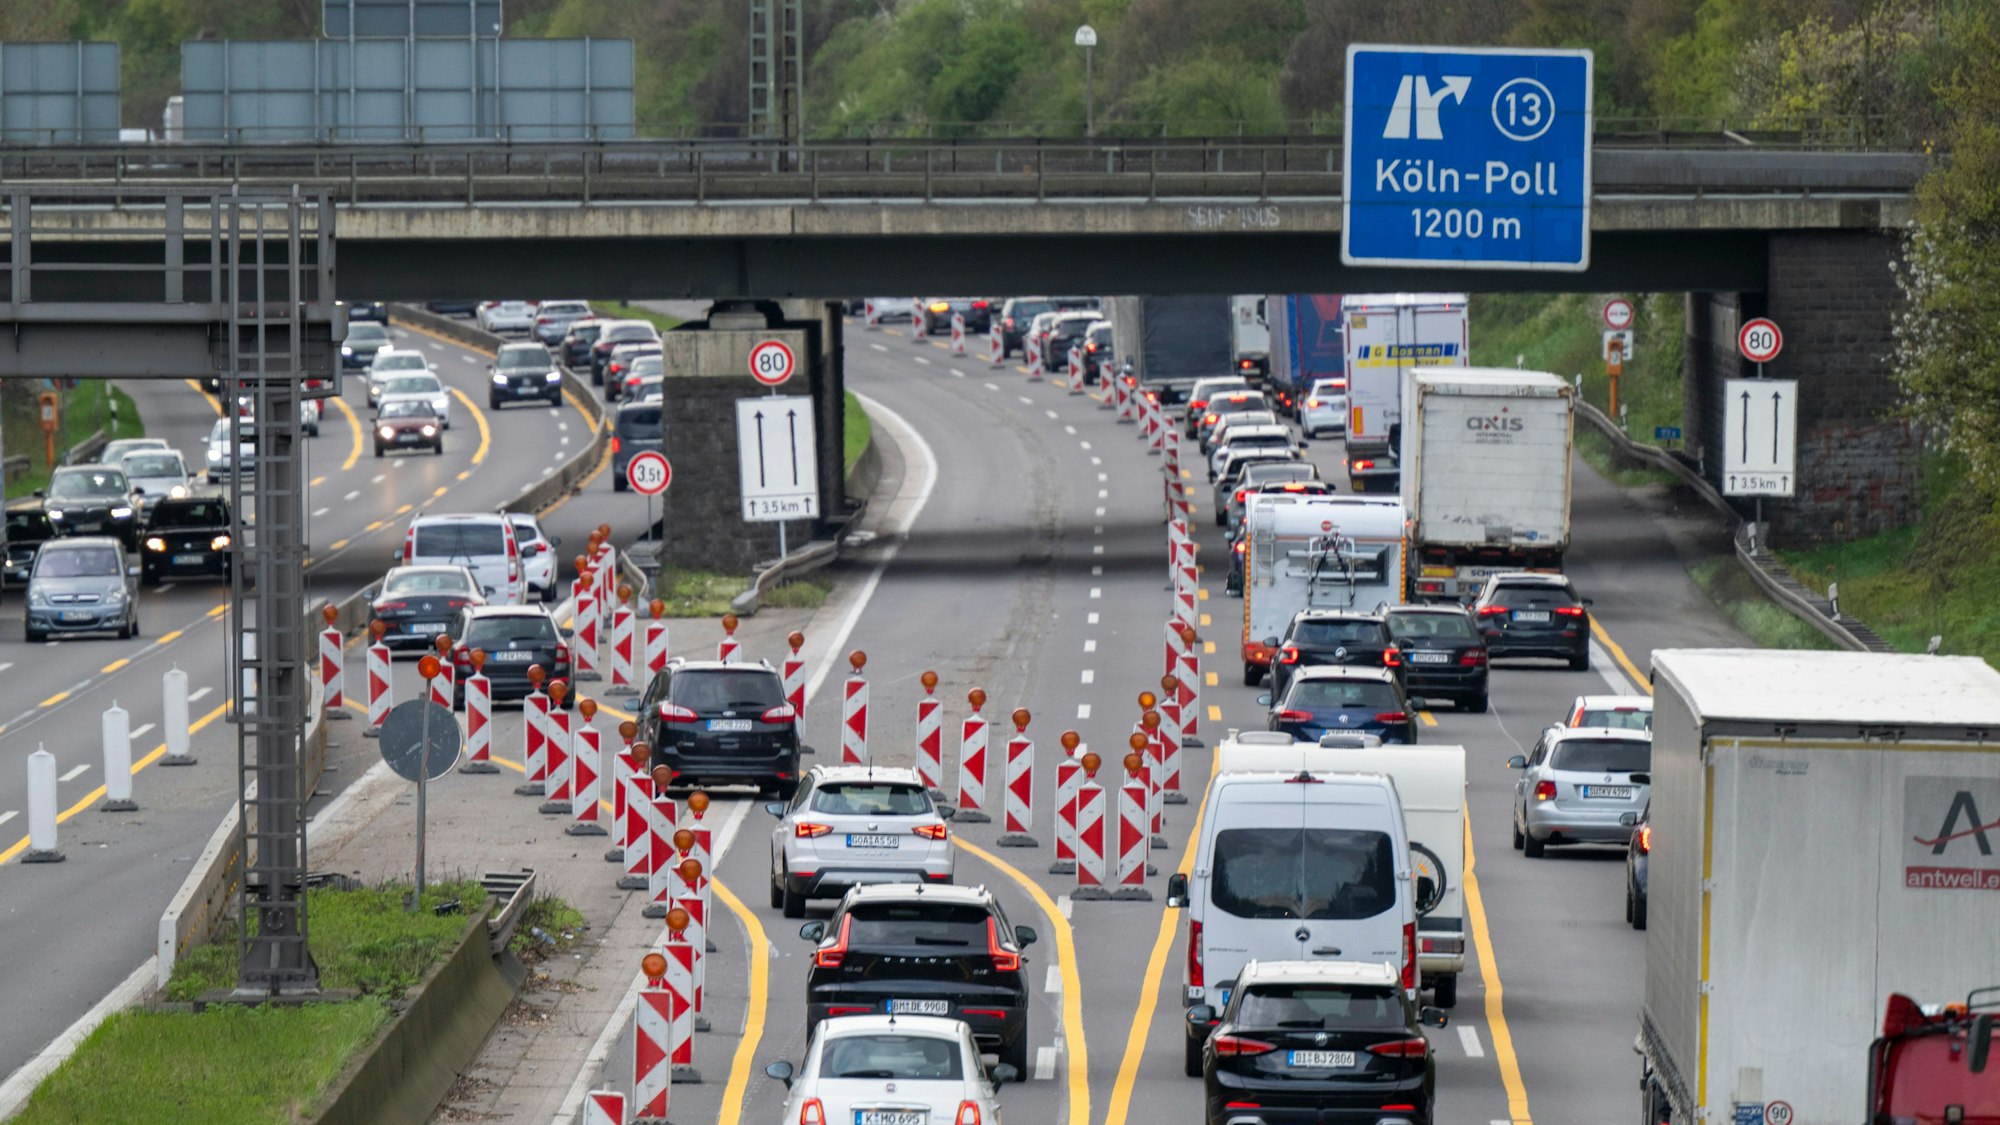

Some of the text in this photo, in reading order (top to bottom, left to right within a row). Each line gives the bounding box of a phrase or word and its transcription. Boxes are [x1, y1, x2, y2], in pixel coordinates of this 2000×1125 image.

[1506, 92, 1541, 126] 13
[1376, 158, 1558, 196] Köln-Poll
[1412, 208, 1521, 240] 1200 m
[1750, 331, 1772, 350] 80
[760, 352, 785, 373] 80
[1466, 407, 1524, 432] axis
[1759, 477, 1777, 490] km
[781, 499, 799, 513] km
[924, 1002, 948, 1012] 9908
[1328, 1052, 1353, 1064] 2806
[898, 1113, 921, 1125] 695
[1771, 1106, 1788, 1120] 90
